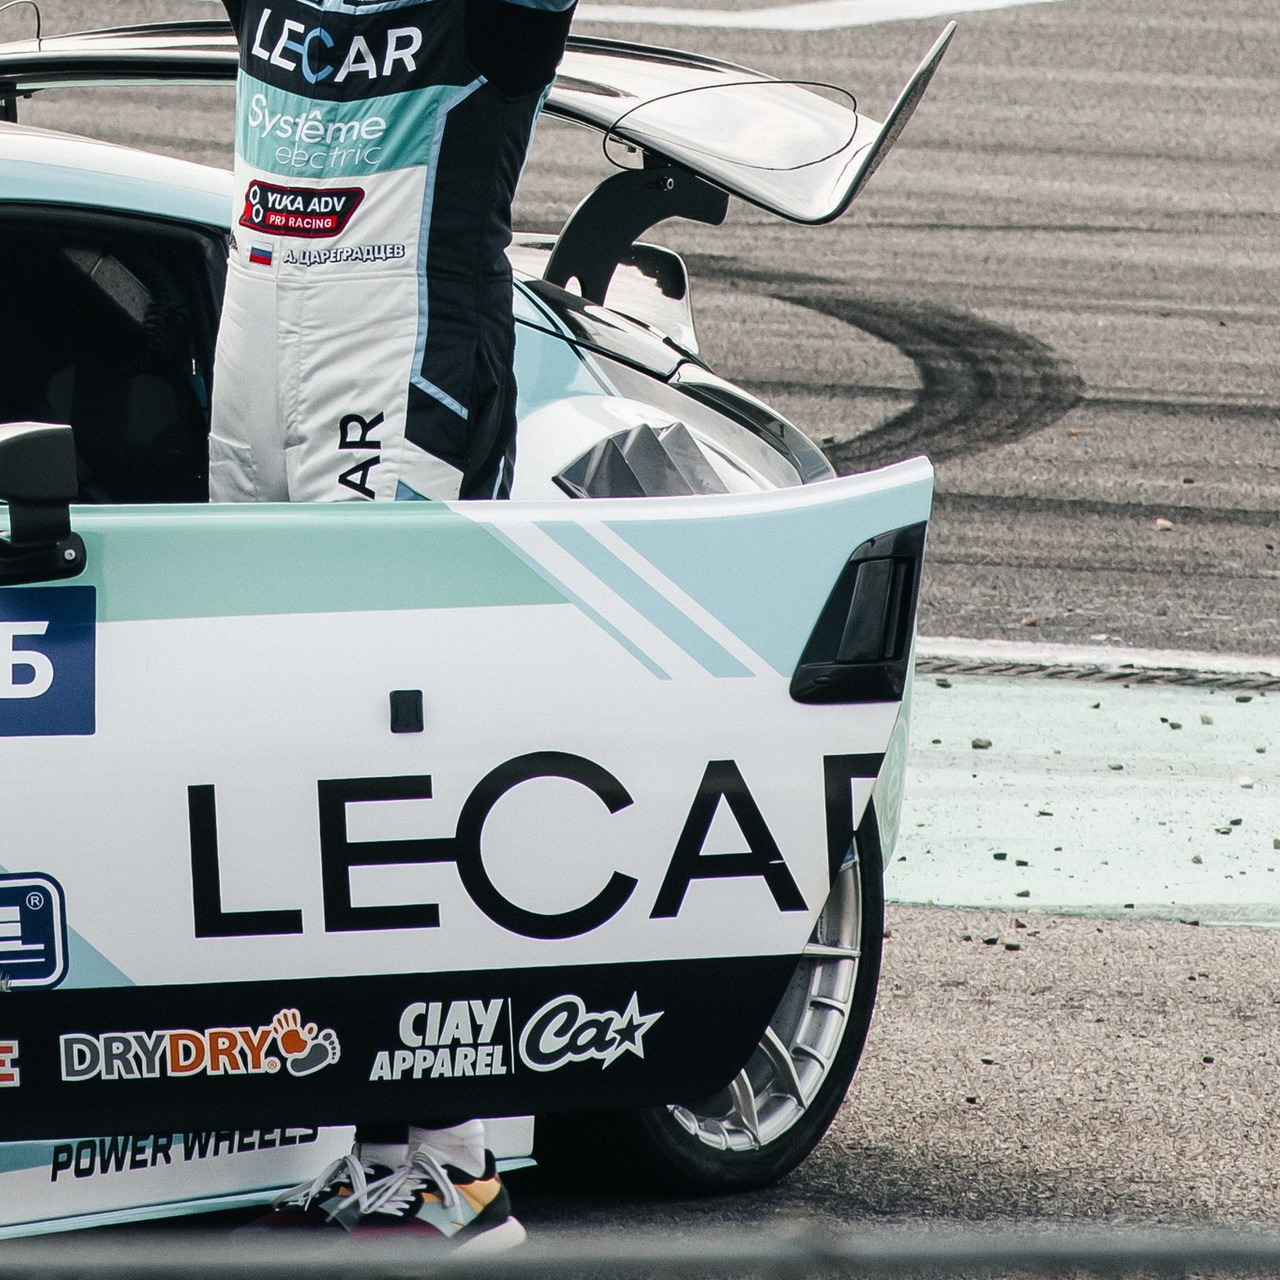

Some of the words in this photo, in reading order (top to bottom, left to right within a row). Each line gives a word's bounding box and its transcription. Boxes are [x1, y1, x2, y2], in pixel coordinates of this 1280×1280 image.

[252, 8, 423, 85] LECAR
[248, 93, 387, 144] Systême
[267, 192, 304, 212] YUKA
[307, 195, 347, 213] ADV
[288, 217, 333, 229] RACING
[299, 244, 406, 267] ЦАРЕГРАДЦЕВ
[337, 411, 385, 500] AR
[60, 1027, 276, 1081] DRYDRY
[369, 1045, 507, 1082] APPAREL
[50, 1134, 172, 1183] POWER
